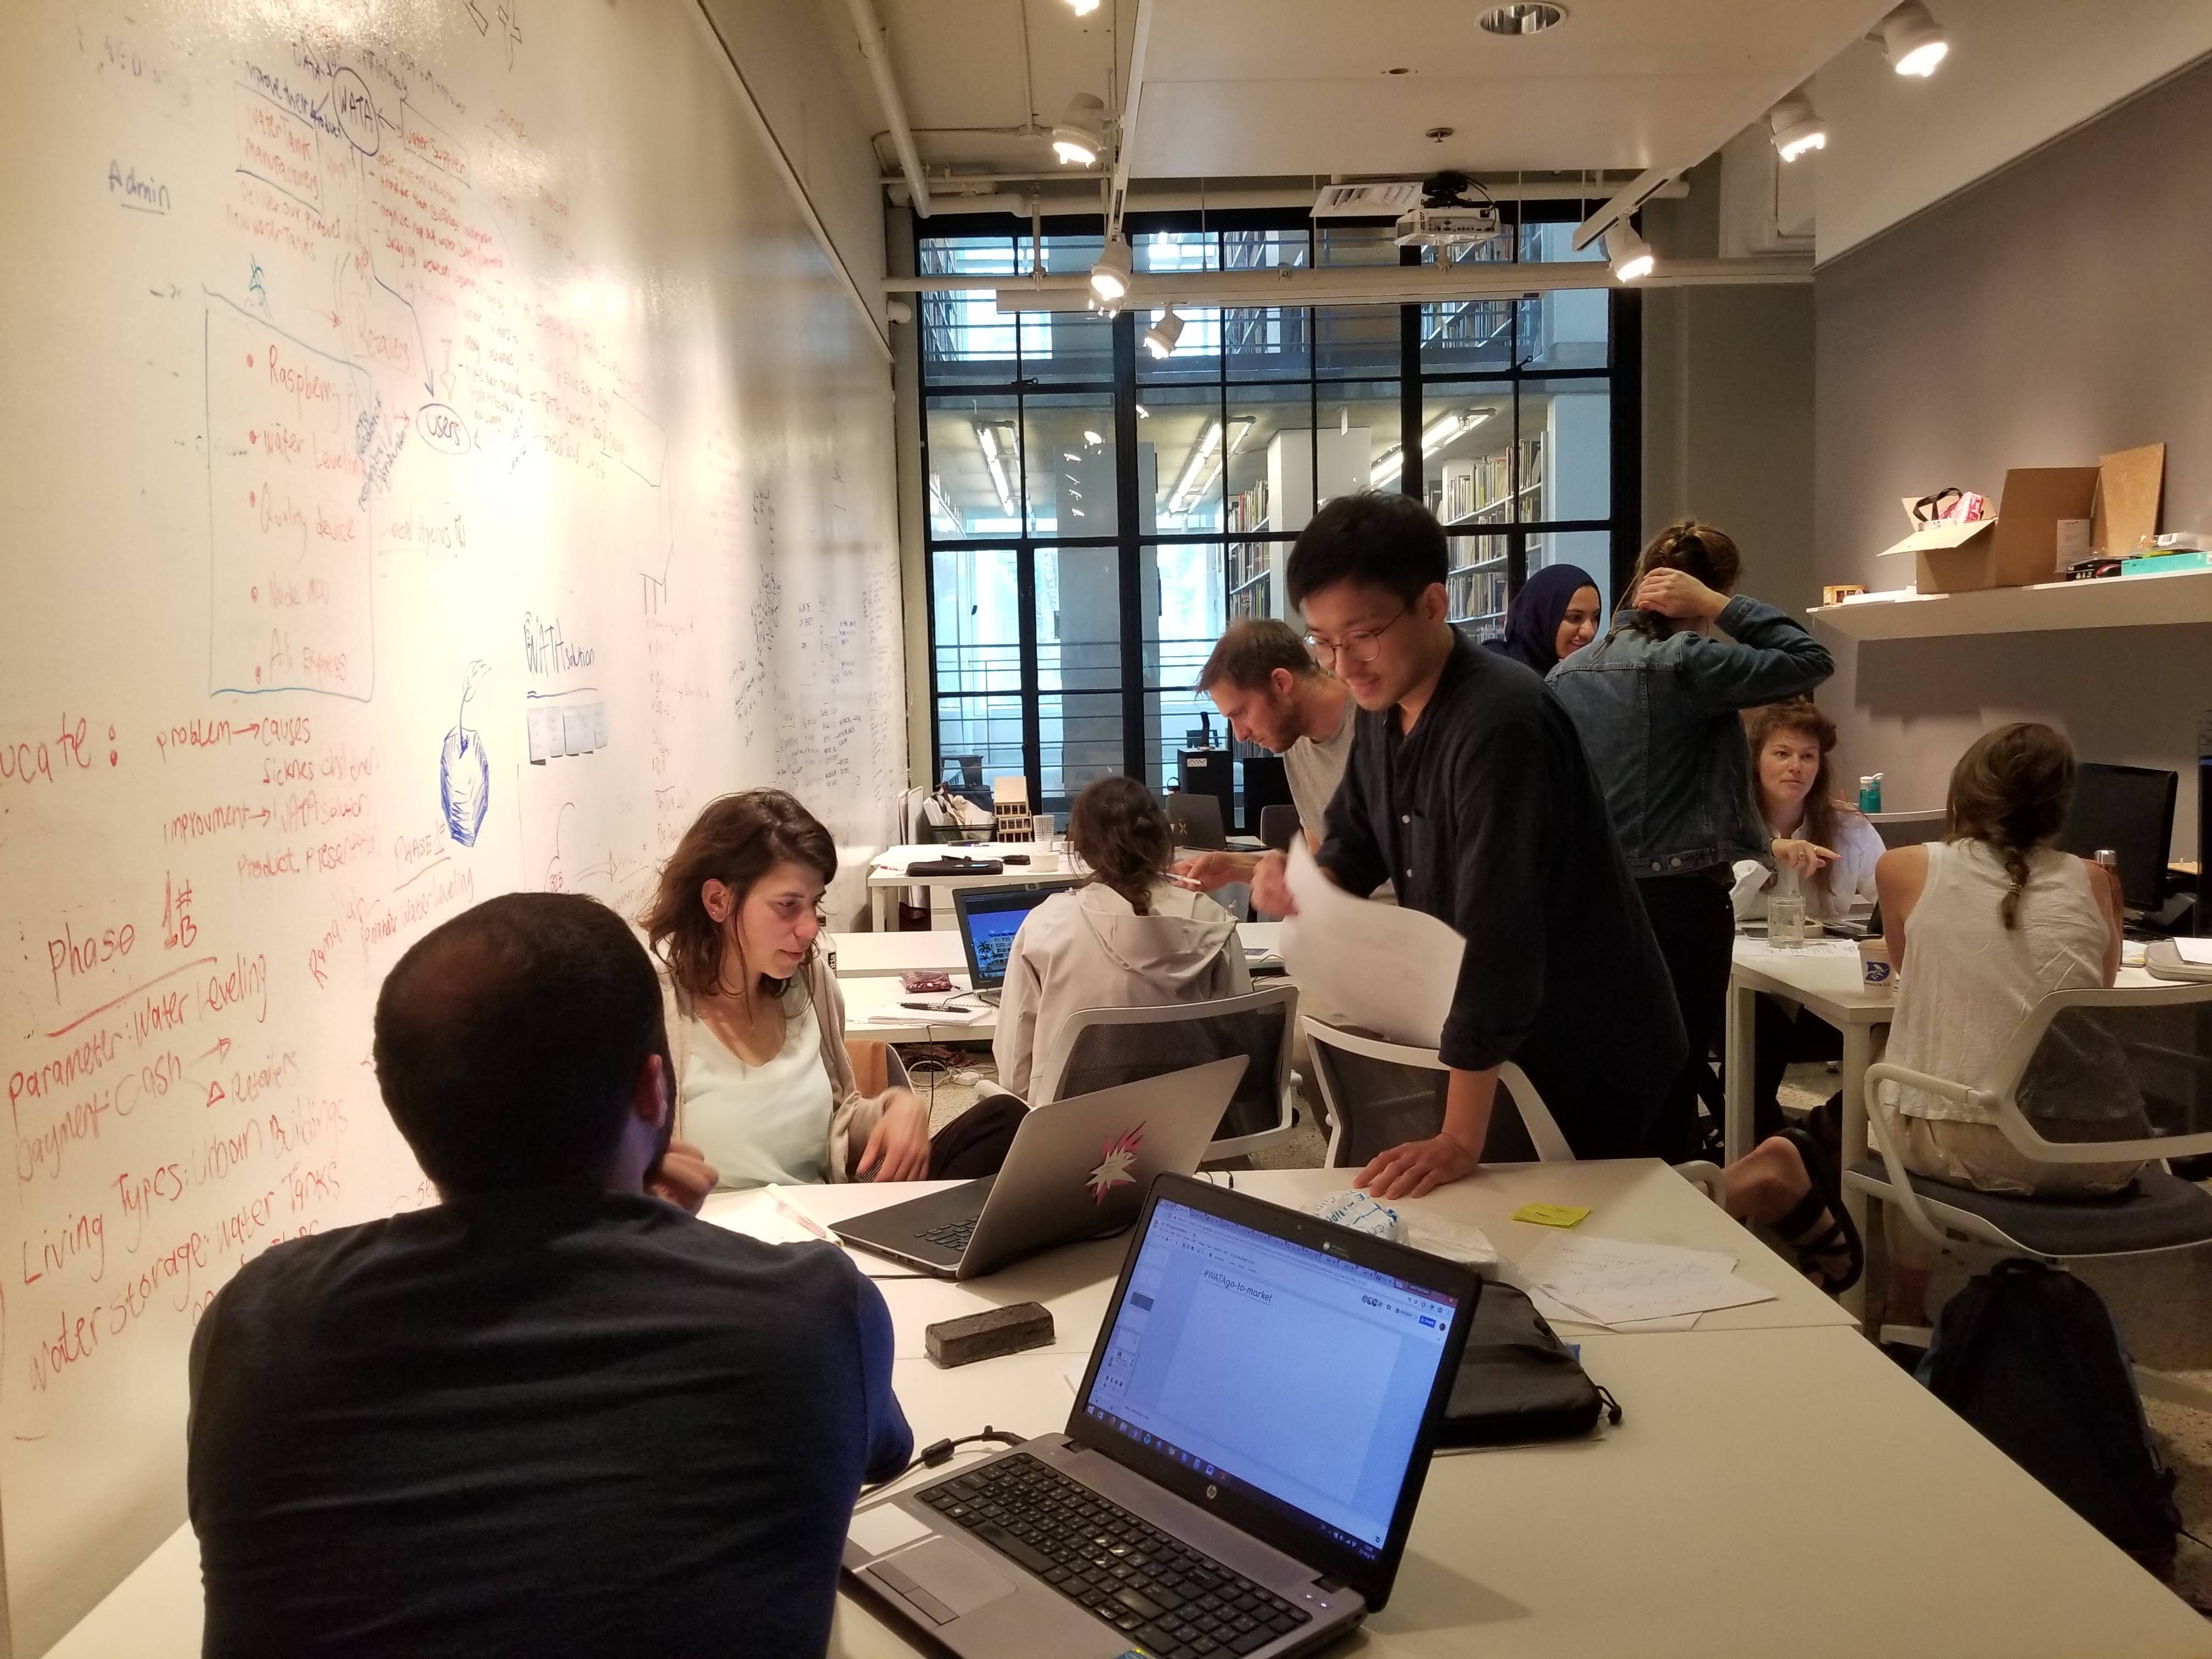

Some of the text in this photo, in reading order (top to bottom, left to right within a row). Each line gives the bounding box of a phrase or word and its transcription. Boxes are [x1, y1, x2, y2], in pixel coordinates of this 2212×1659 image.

[340, 89, 375, 130] WATA
[108, 161, 170, 214] Admin
[565, 644, 595, 669] solution
[156, 719, 232, 764] problem
[133, 992, 187, 1040] Water
[22, 1214, 106, 1285] Living
[1203, 1269, 1273, 1304] #WATAgo-to-market
